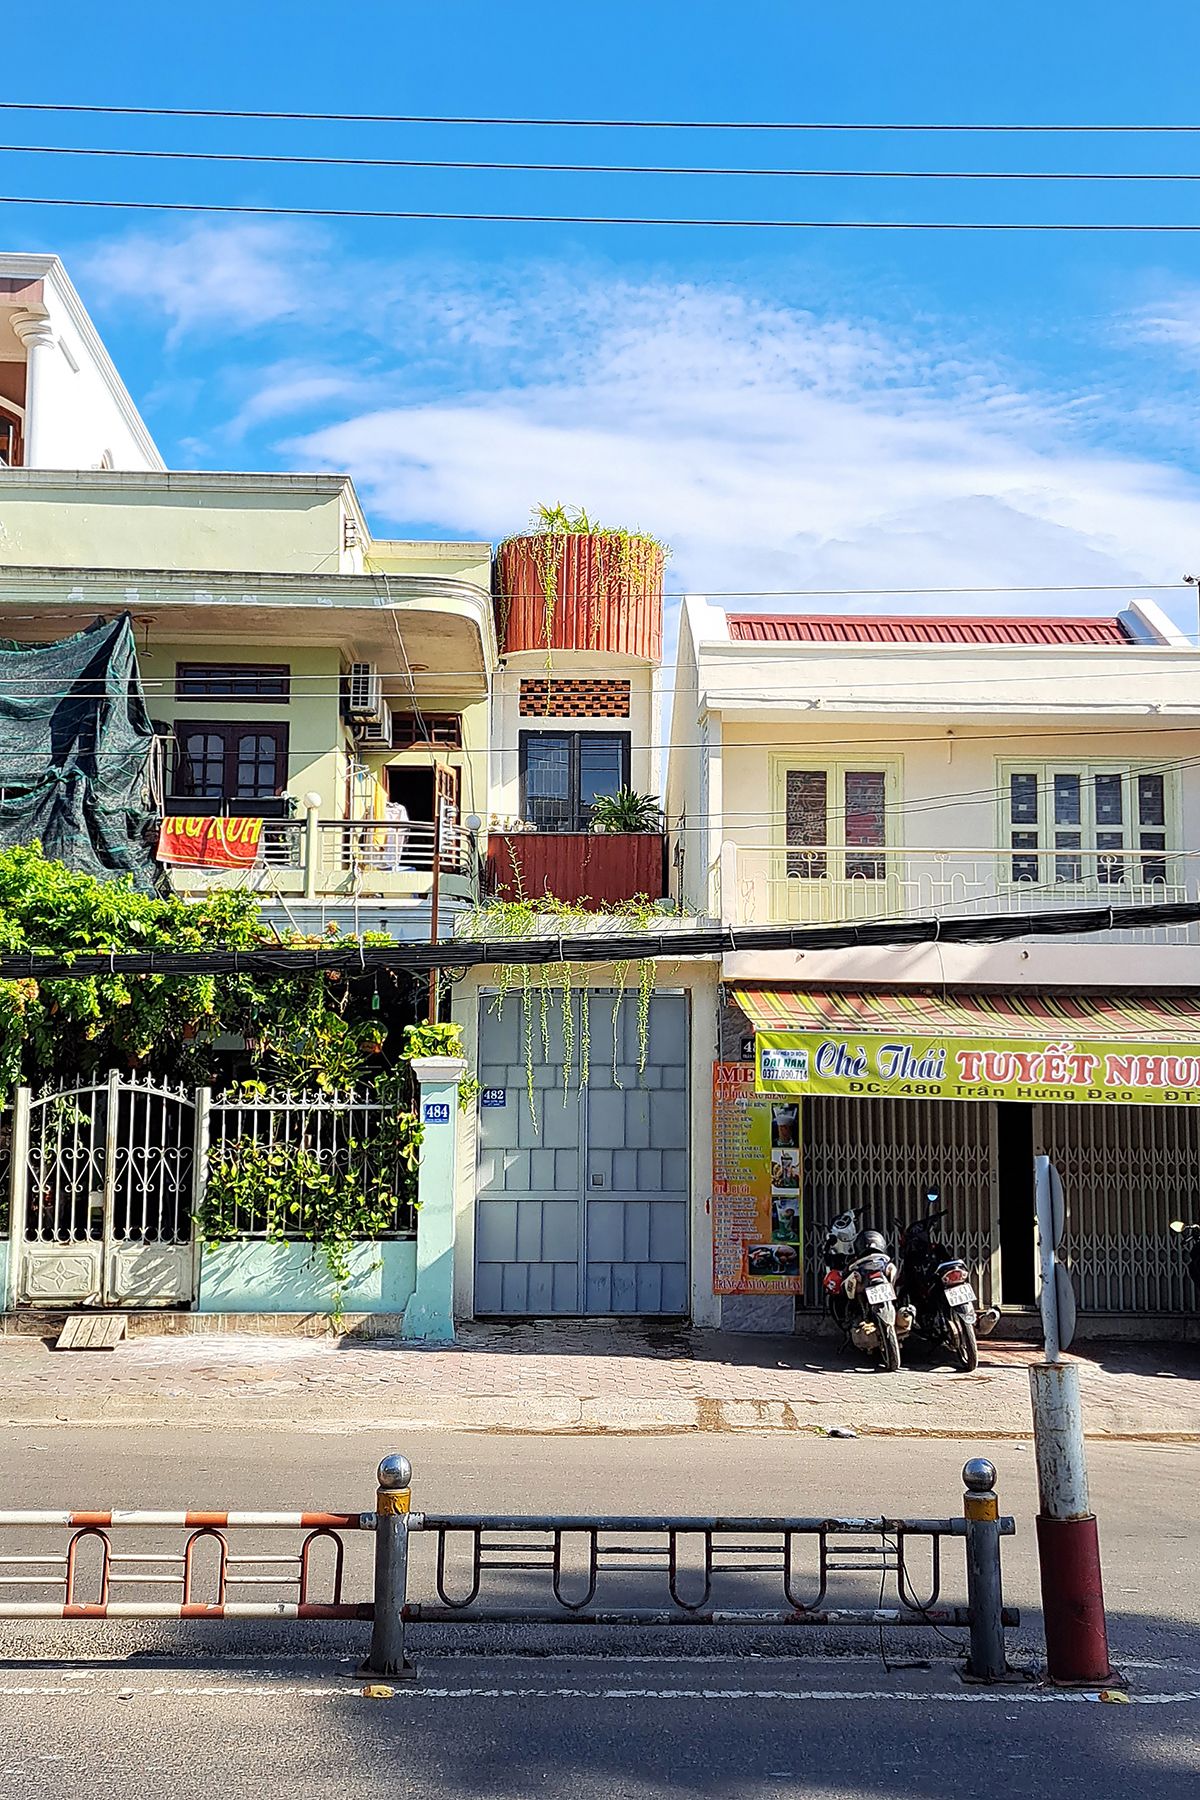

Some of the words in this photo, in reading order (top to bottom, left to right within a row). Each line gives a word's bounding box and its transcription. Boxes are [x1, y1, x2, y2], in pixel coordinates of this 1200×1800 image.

[764, 1057, 781, 1069] ĐẠI
[784, 1058, 806, 1068] NAM
[814, 1040, 870, 1080] Chè
[876, 1043, 948, 1081] Thái
[956, 1042, 1099, 1087] TUYẾT
[1104, 1054, 1200, 1089] NHU
[484, 1090, 504, 1100] 482
[849, 1082, 889, 1094] ĐC:
[900, 1084, 941, 1095] 480
[952, 1084, 1005, 1098] Trần
[1017, 1086, 1075, 1101] Hưng
[1088, 1088, 1132, 1102] Đạo
[426, 1105, 448, 1118] 484
